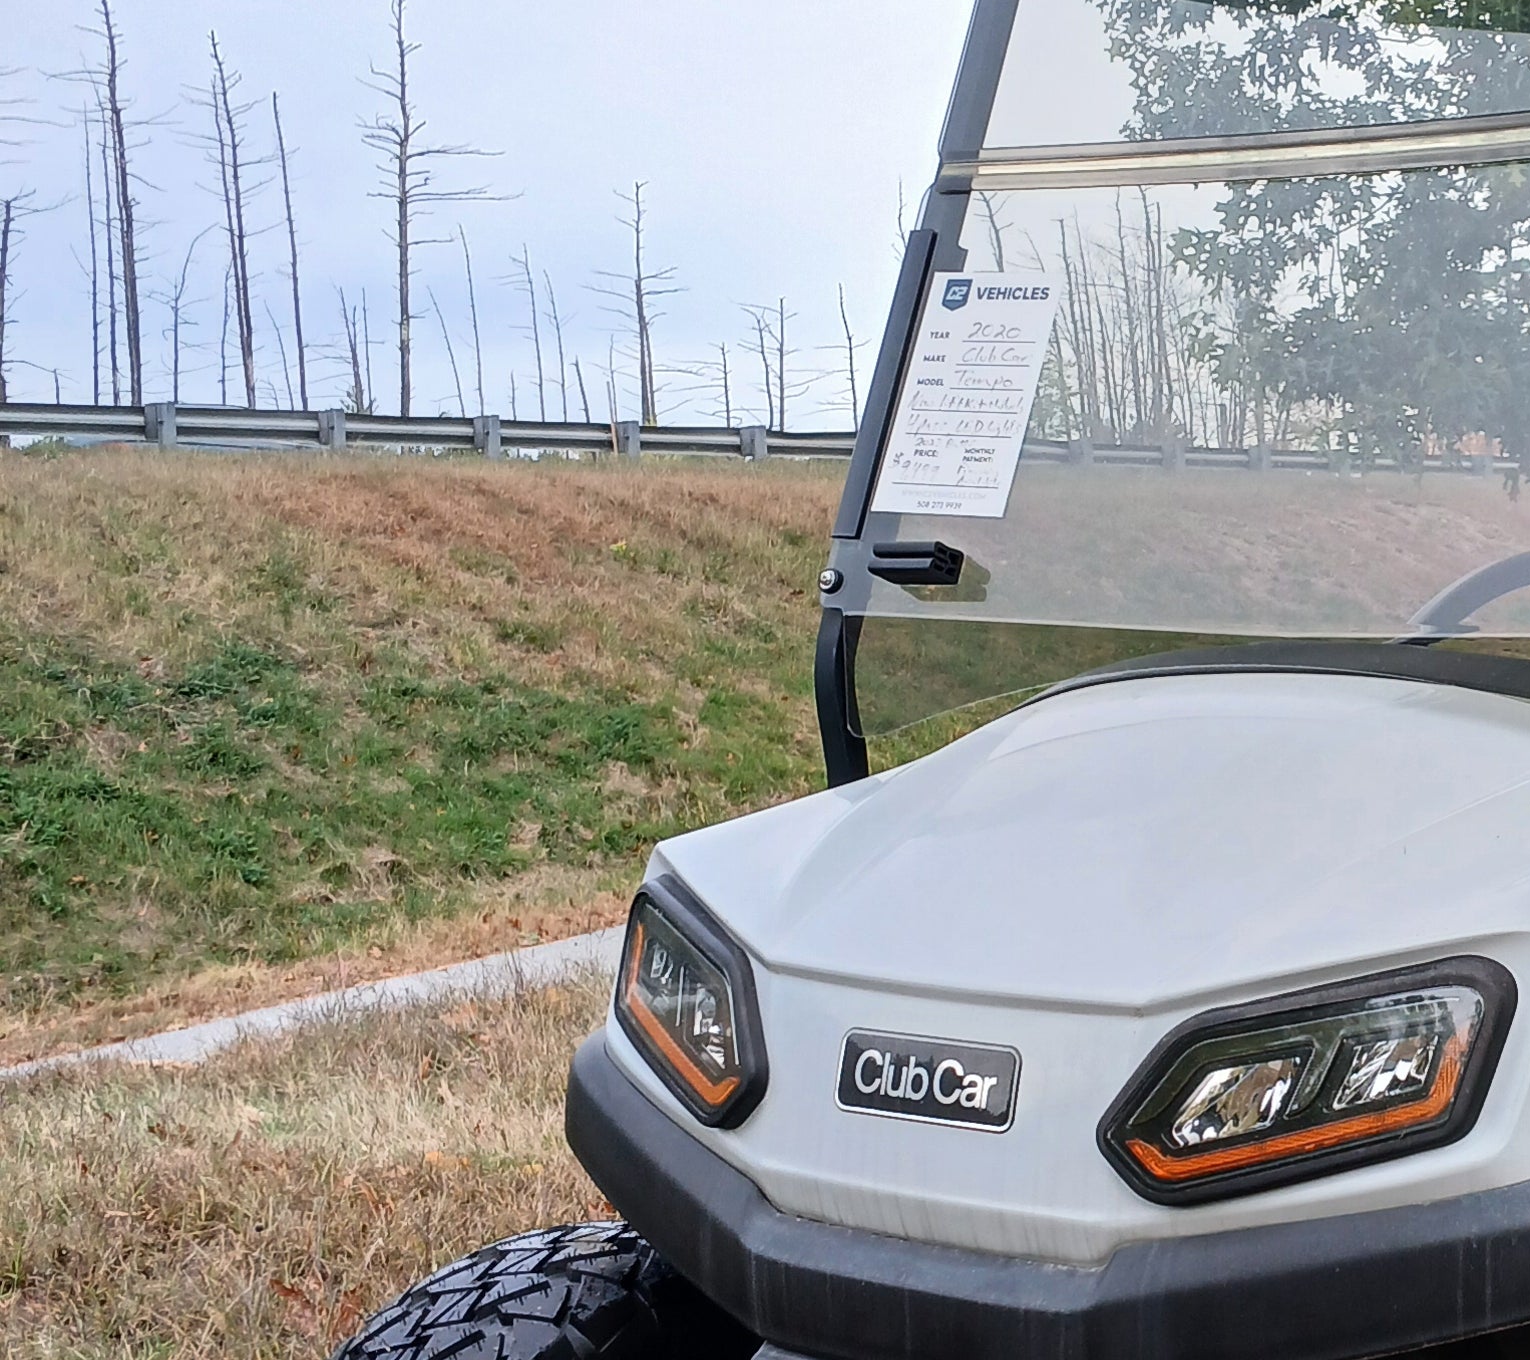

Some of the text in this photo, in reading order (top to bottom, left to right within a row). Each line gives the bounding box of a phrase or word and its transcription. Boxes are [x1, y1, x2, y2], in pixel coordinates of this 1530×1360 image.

[976, 286, 1050, 300] VEHICLES
[930, 331, 950, 339] YEAR
[967, 322, 1021, 339] 2020
[923, 355, 946, 363] MAKE
[917, 378, 944, 386] MODEL
[854, 1048, 998, 1110] Club Car
